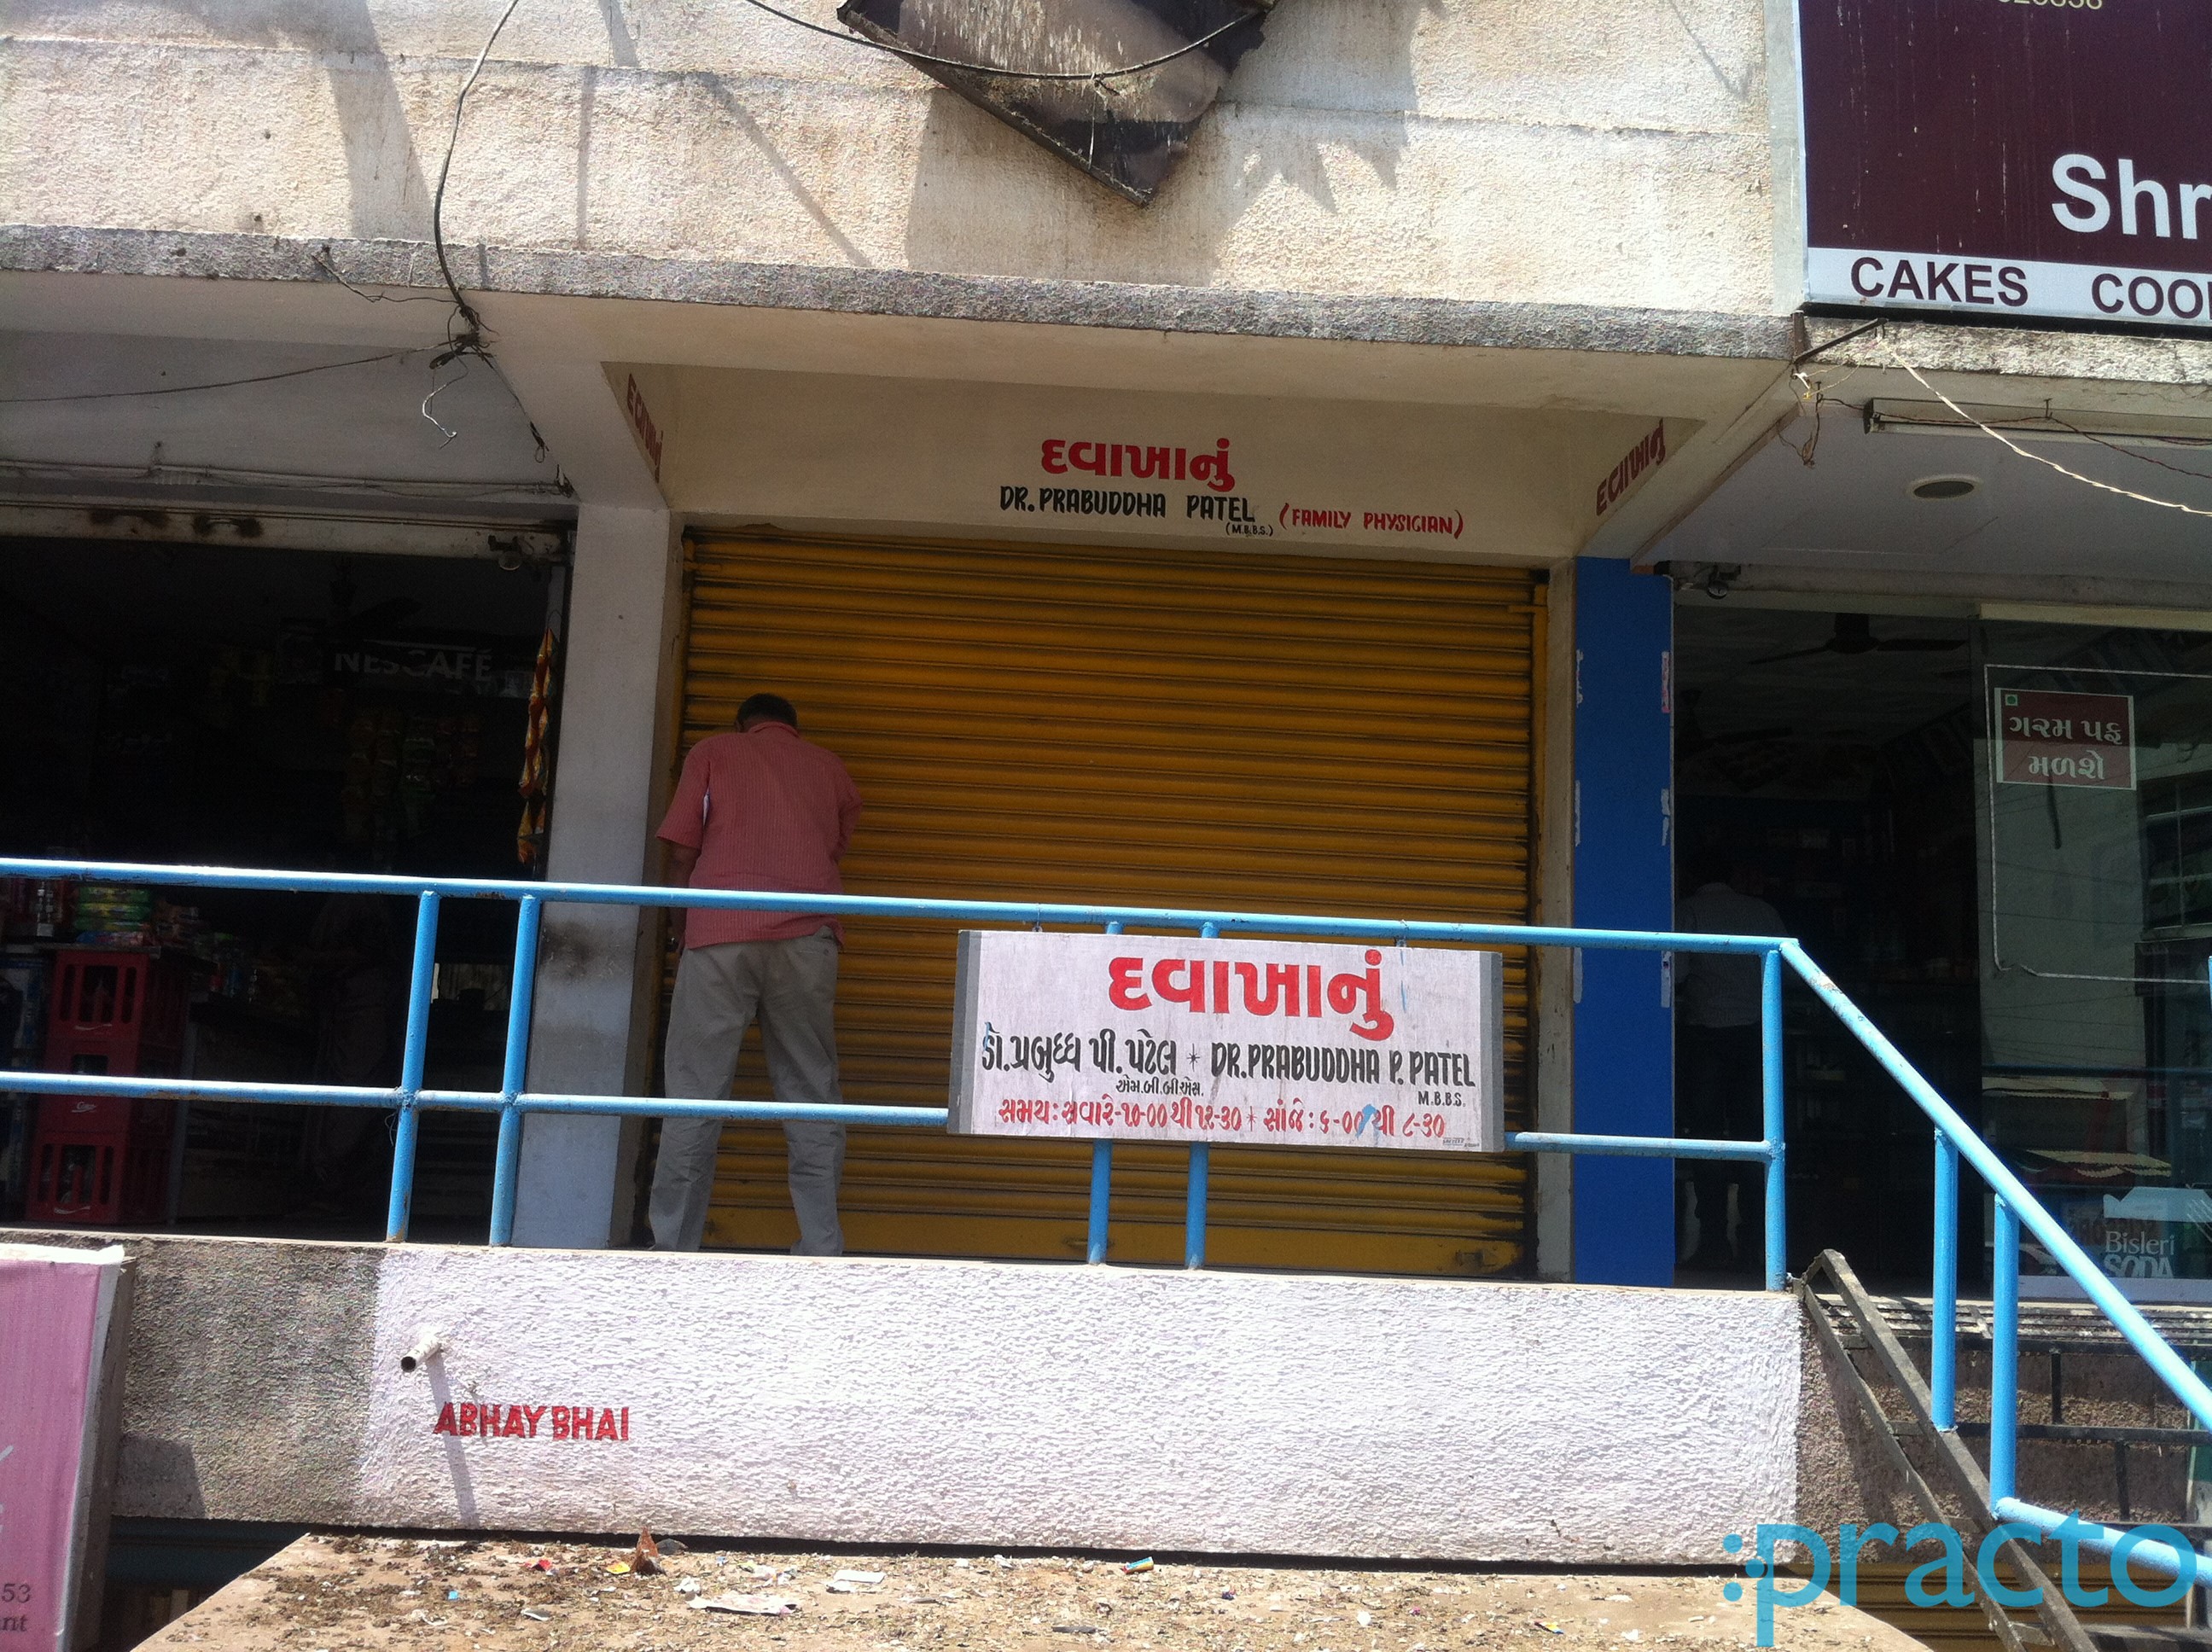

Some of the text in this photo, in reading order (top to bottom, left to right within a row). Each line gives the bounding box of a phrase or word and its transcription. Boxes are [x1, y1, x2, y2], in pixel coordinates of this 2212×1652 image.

[1851, 257, 2212, 321] CAKES COO
[1040, 438, 1236, 492] દવાખાનું
[1186, 494, 1257, 522] PATEL
[1279, 503, 1352, 529] (FAMILY
[2009, 716, 2123, 746] ગરમ પફ
[2028, 750, 2105, 780] મળશે
[1109, 949, 1395, 1042] દવાખાનું
[1417, 1091, 1467, 1108] M.B.B.S.
[2104, 1230, 2175, 1255] Bisleri
[2104, 1254, 2174, 1278] SODA
[433, 1401, 630, 1442] ABHAY BHAI
